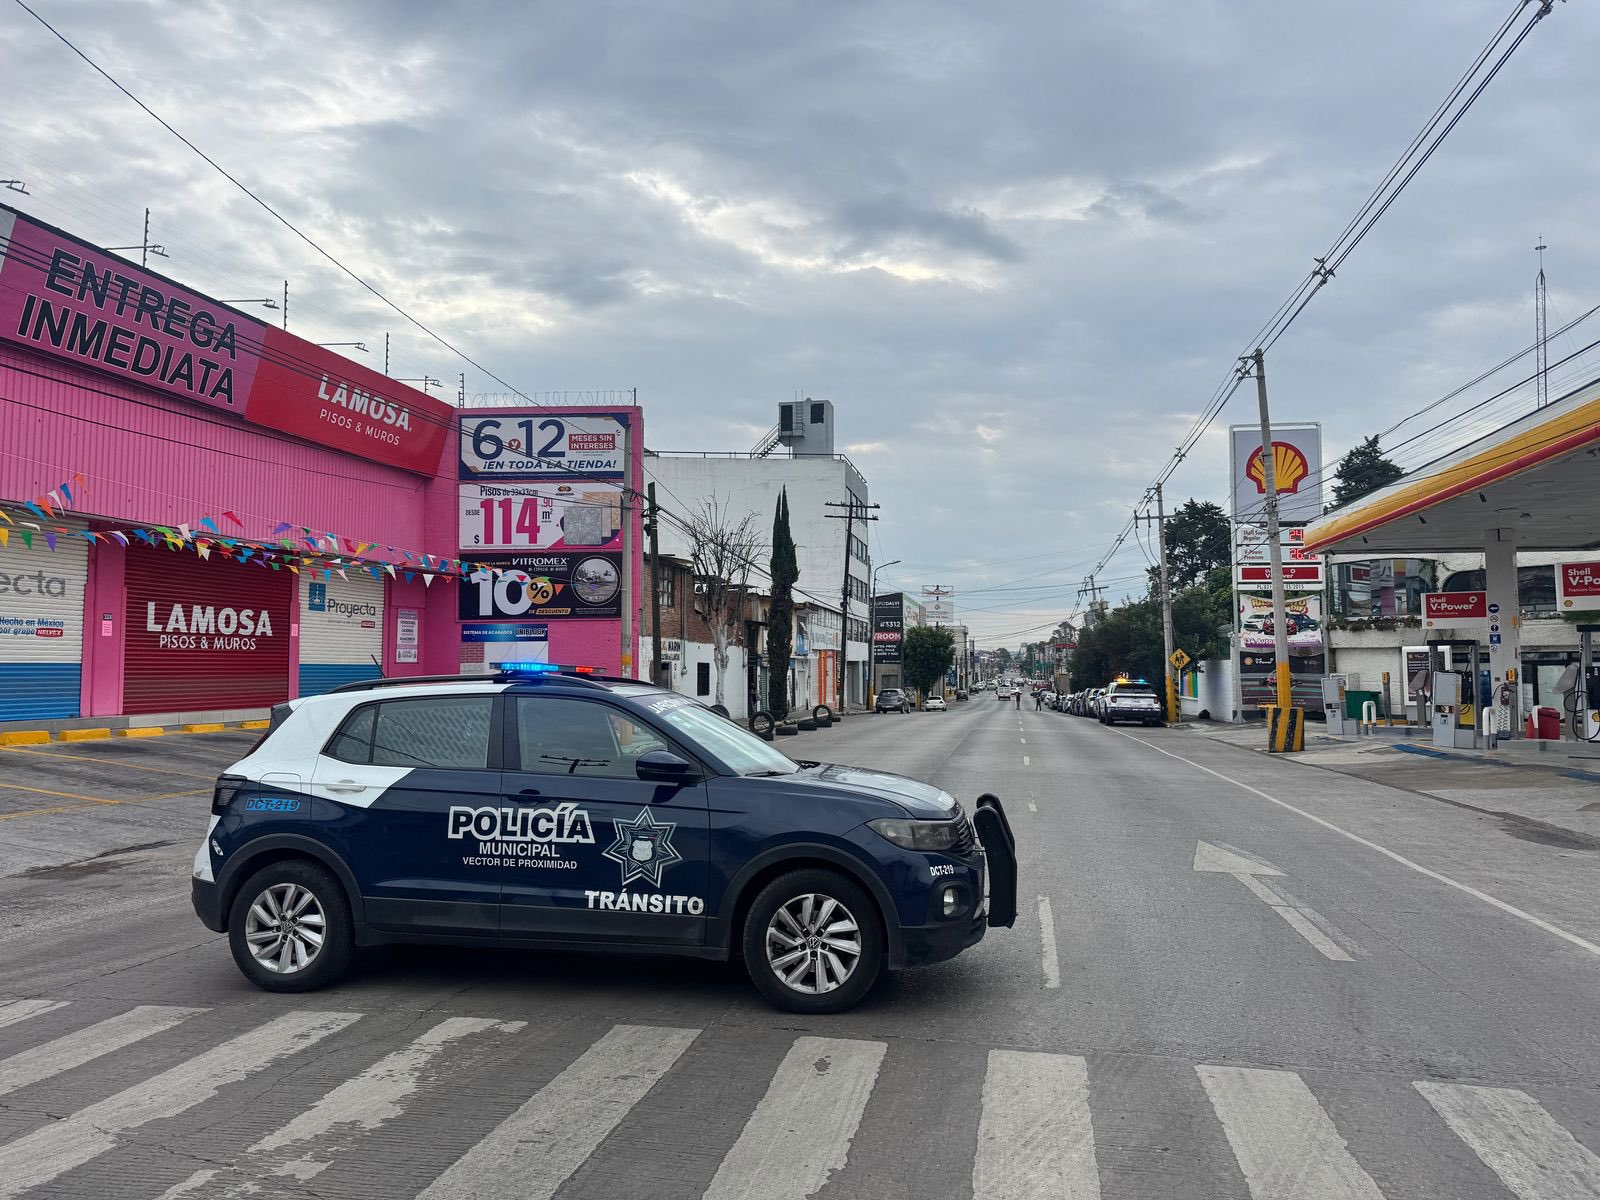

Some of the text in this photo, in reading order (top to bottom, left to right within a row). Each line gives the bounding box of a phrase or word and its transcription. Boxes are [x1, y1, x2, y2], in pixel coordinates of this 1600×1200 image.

[44, 247, 238, 361] ENTREGA
[17, 293, 235, 406] INMEDIATA
[317, 373, 412, 432] LAMOSA
[319, 408, 401, 446] PISOS & MUROS
[472, 419, 504, 460] 6
[518, 419, 566, 458] 12
[571, 442, 614, 450] INTERESES
[509, 460, 543, 469] TODA
[546, 460, 563, 469] LA
[567, 460, 617, 470] TIENDA!
[480, 485, 501, 497] Pisos
[474, 534, 480, 544] $
[480, 497, 541, 545] 114
[512, 557, 568, 567] VITROMEX
[1567, 567, 1591, 576] Shell
[327, 598, 376, 618] Proyecta
[1430, 603, 1474, 611] V-Power
[146, 601, 273, 637] LAMOSA
[159, 635, 257, 651] PISOS & MUROS
[245, 797, 300, 811] DCT-219
[448, 802, 596, 843] POLICÍA
[479, 841, 560, 857] MUNICIPAL
[463, 856, 578, 869] VECTOR DE PROXIMIDAD
[929, 864, 955, 877] DCT-219
[584, 888, 705, 915] TRÁNSITO
